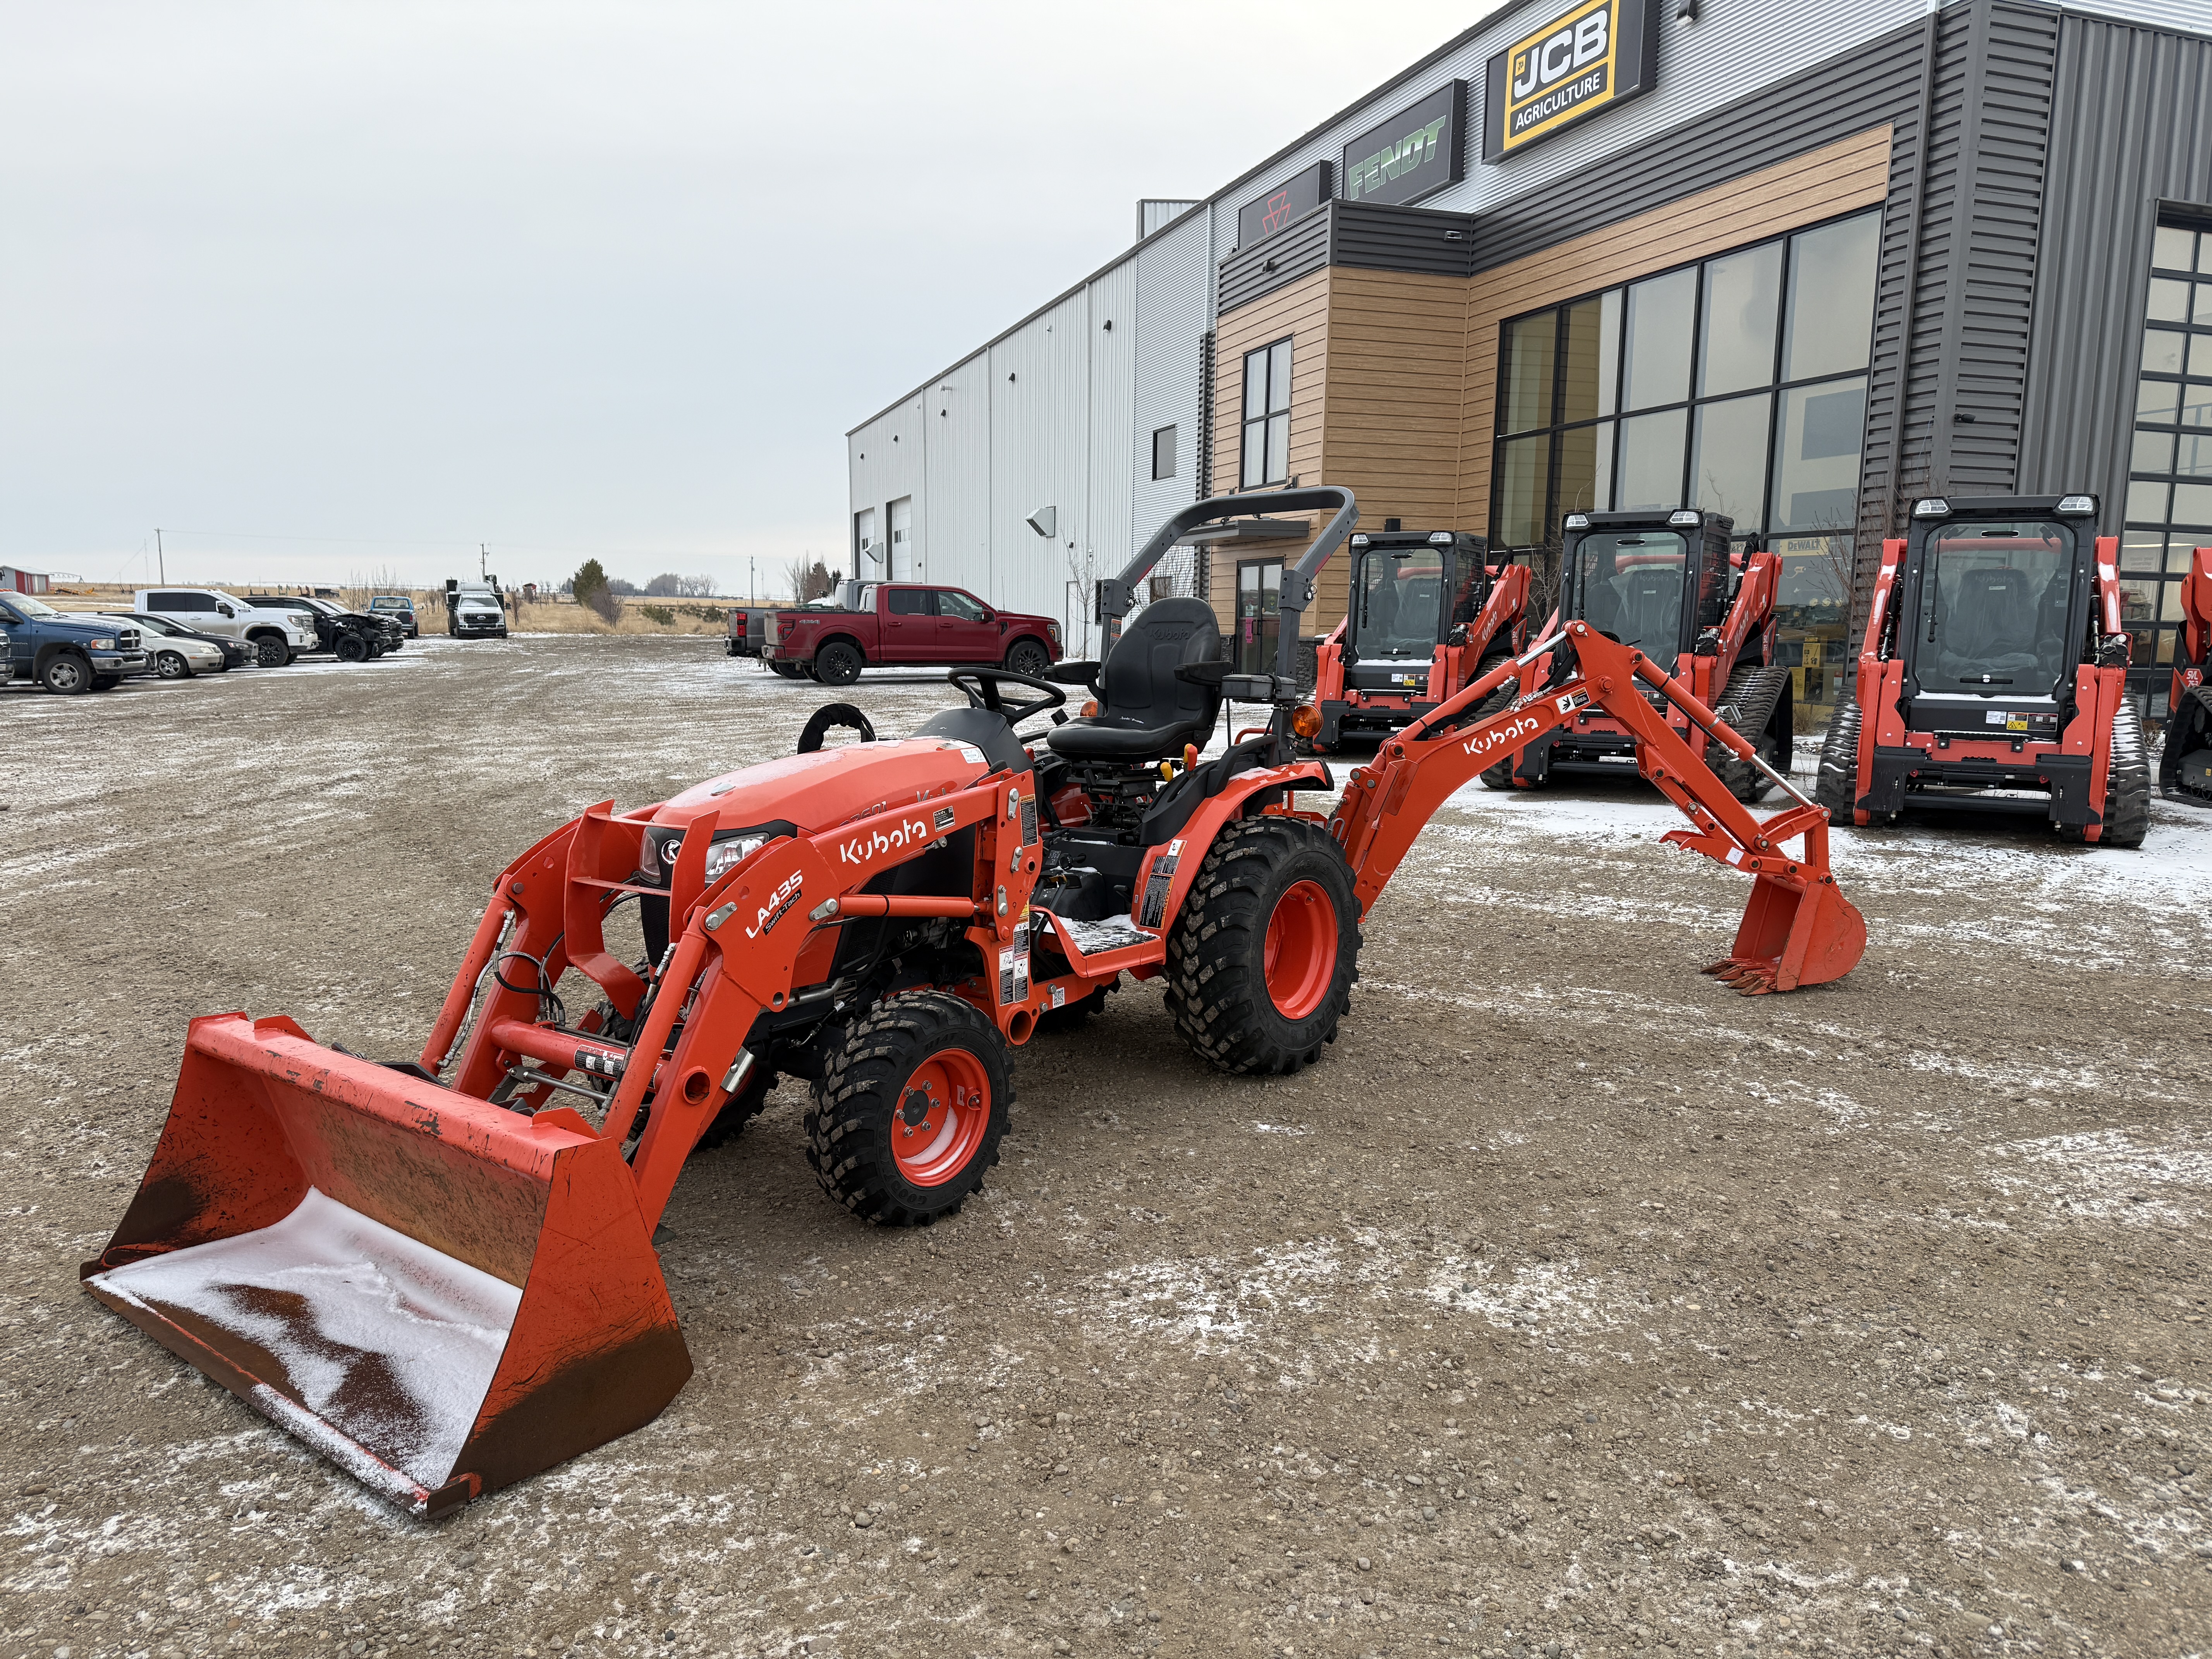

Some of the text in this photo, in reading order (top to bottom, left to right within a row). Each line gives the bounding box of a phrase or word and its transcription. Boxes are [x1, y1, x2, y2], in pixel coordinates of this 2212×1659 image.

[1515, 10, 1607, 98] JCB
[1515, 72, 1600, 130] AGRICULTURE
[1348, 115, 1446, 201] FENDT
[1150, 628, 1191, 640] Kubota
[1482, 611, 1497, 641] Kubota
[1735, 610, 1748, 647] Kubota
[2186, 670, 2198, 680] SVL
[1463, 718, 1539, 755] Kubota
[840, 819, 927, 864] Kubota
[745, 869, 803, 939] LA435
[765, 893, 800, 932] Swift-Tach
[878, 1108, 927, 1206] GOODYEAR
